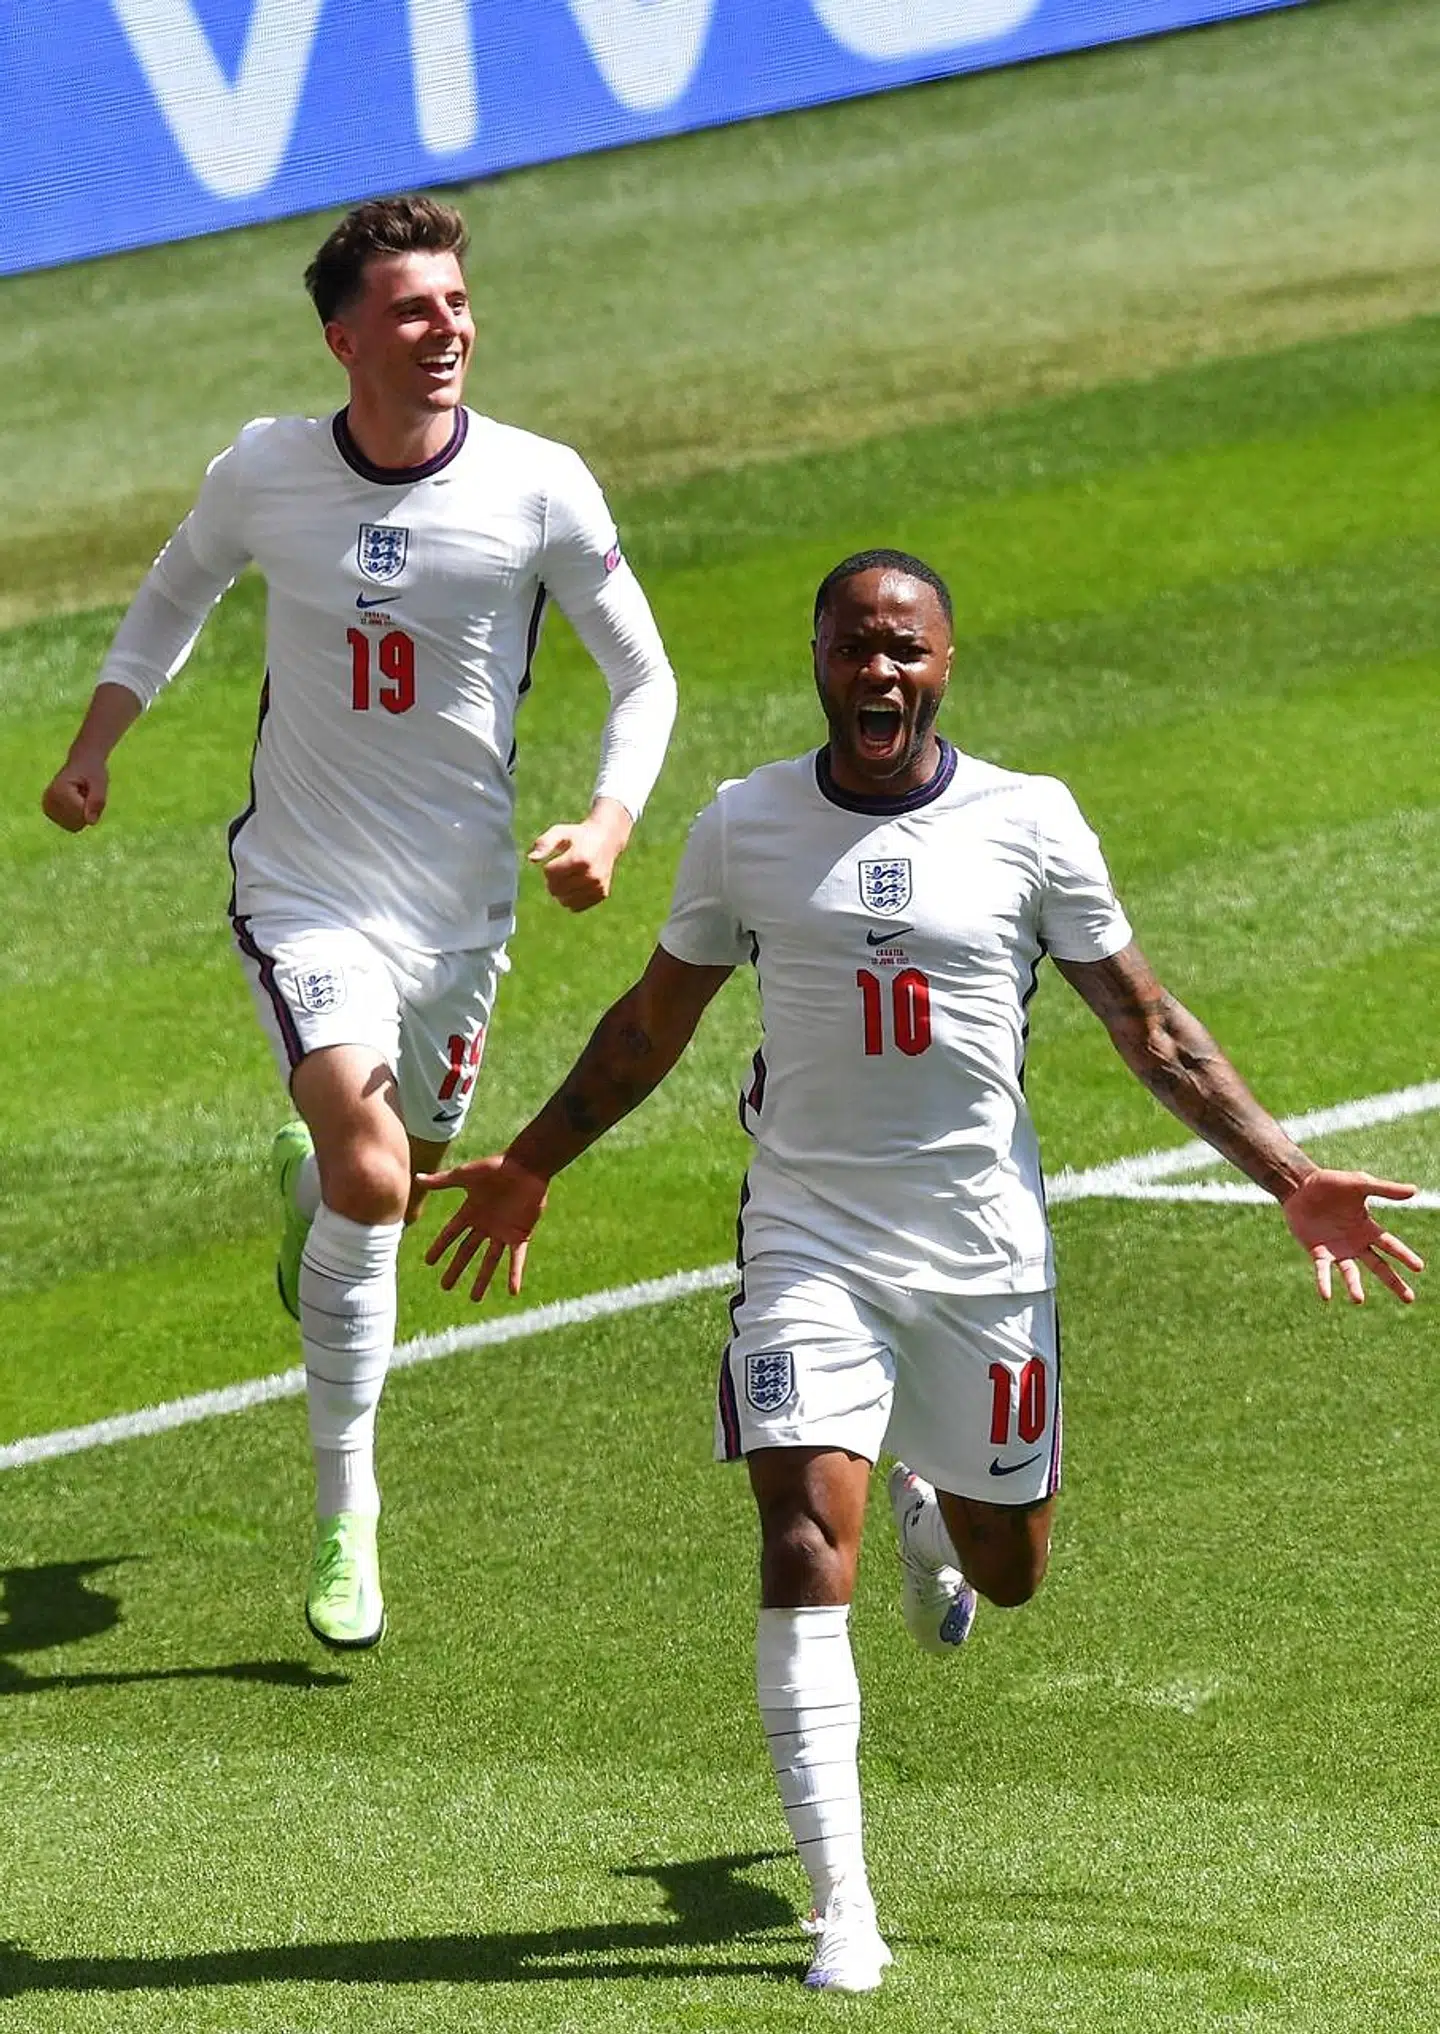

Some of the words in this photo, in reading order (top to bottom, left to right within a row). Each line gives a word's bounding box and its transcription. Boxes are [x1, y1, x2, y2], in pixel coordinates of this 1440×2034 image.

[346, 629, 416, 714] 19
[857, 968, 932, 1056] 10
[989, 1357, 1046, 1444] 10
